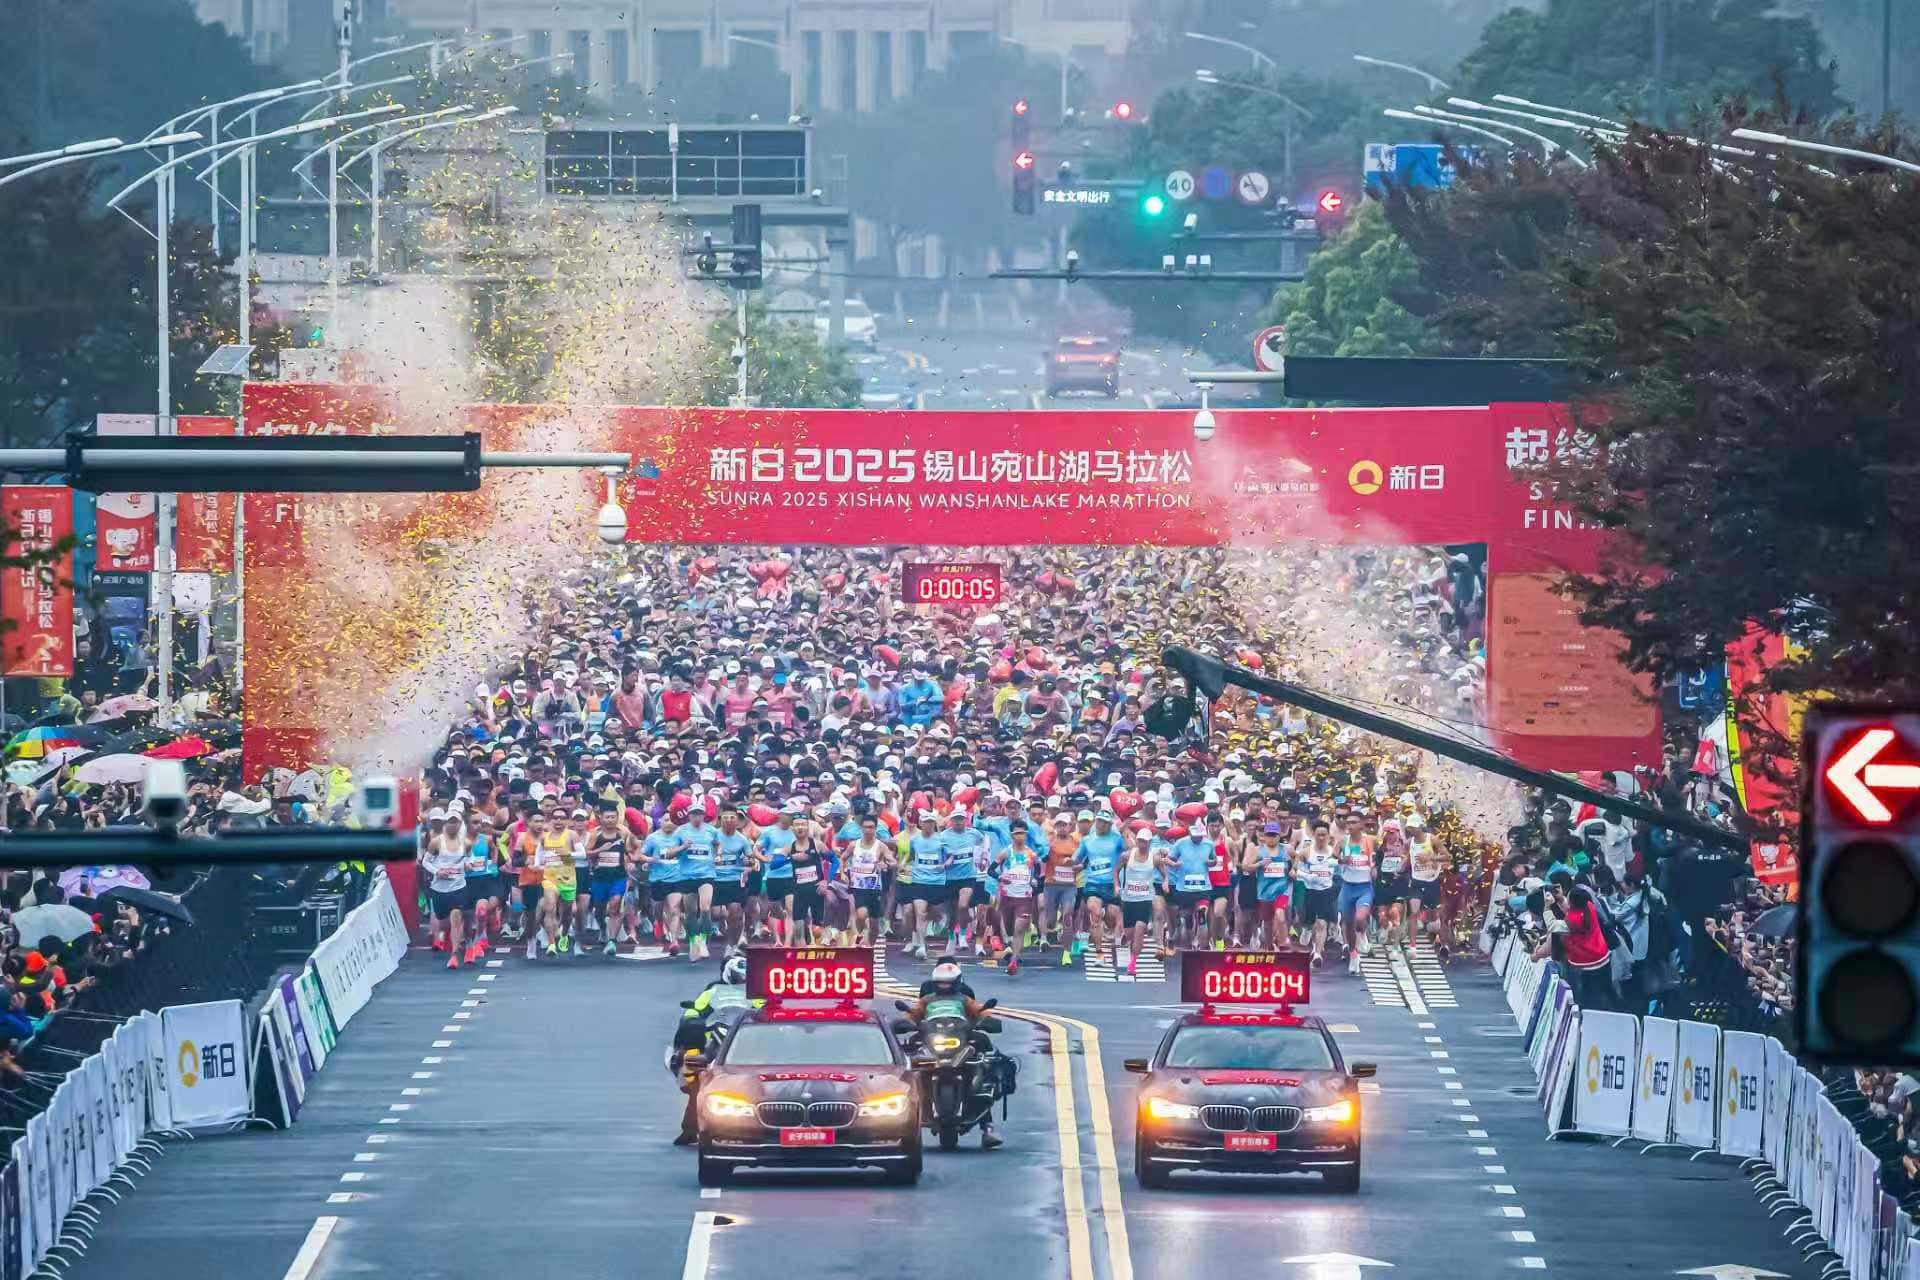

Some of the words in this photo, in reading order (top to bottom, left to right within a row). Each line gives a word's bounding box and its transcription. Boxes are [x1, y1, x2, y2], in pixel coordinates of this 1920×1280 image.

[1044, 190, 1110, 203] 安全文明出行
[1169, 177, 1192, 192] 40
[1389, 464, 1444, 490] 新日
[707, 491, 773, 506] SUNRA
[783, 492, 828, 507] 2025
[838, 492, 911, 508] XISHAN
[919, 493, 1070, 508] WANSHANLAKE
[1078, 493, 1190, 509] MARATHON
[920, 578, 996, 600] 0:00:05
[769, 967, 868, 994] 0:00:05
[1204, 971, 1304, 998] 0:00:04
[202, 1042, 236, 1080] 新日
[1602, 1054, 1626, 1090] 新日
[1653, 1060, 1669, 1096] 新日
[1694, 1065, 1710, 1101] 新日
[1740, 1075, 1757, 1111] 新日
